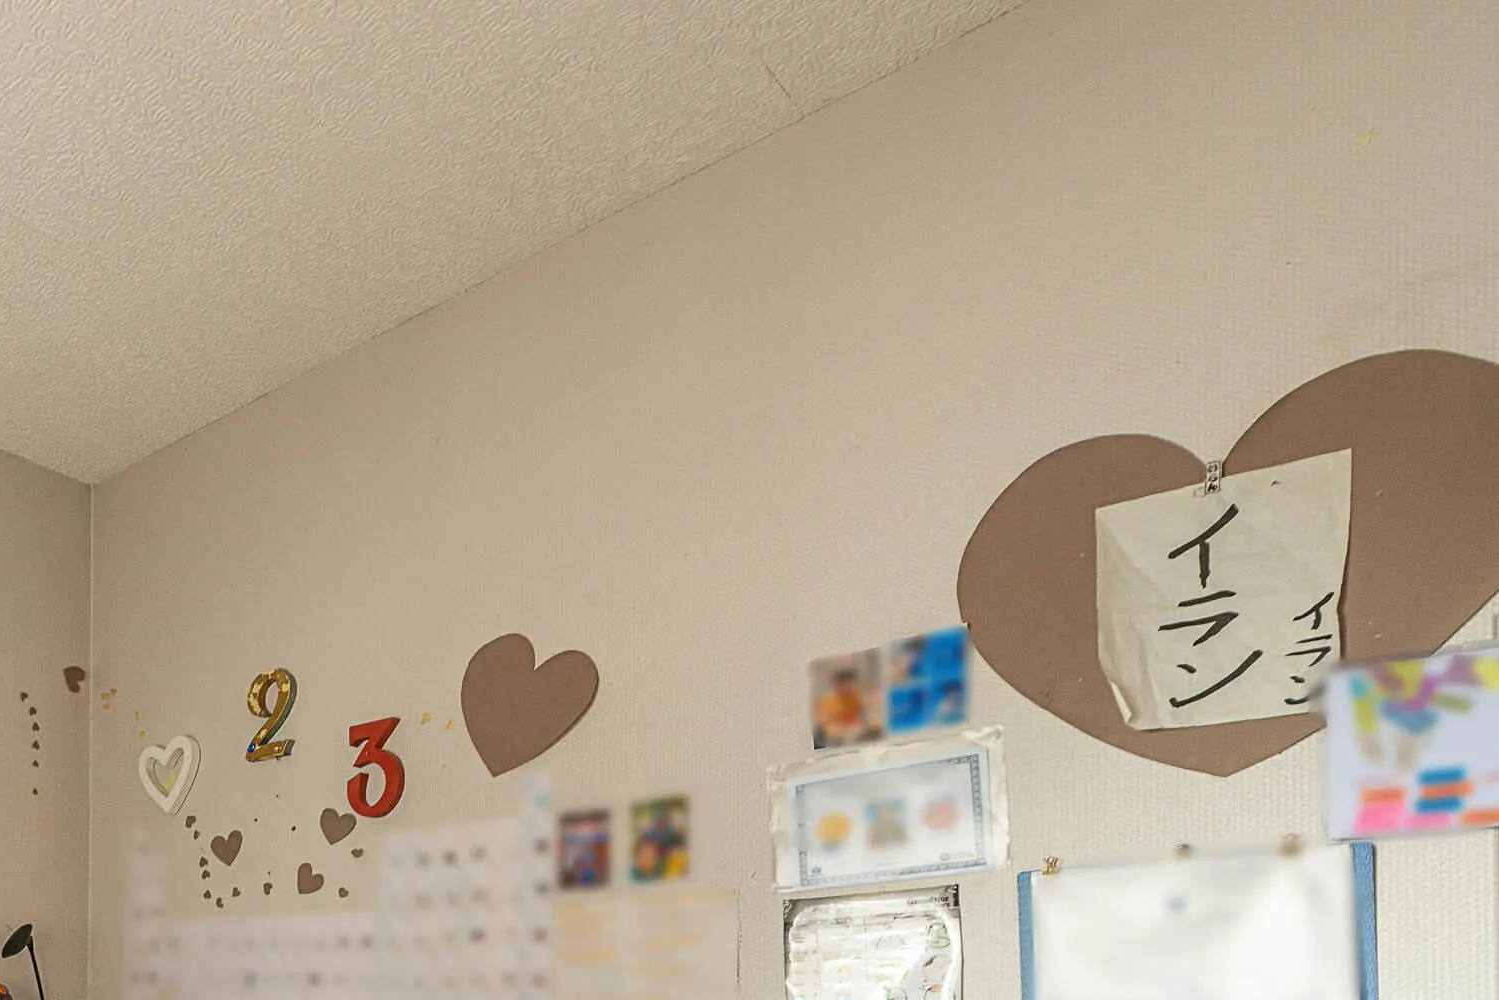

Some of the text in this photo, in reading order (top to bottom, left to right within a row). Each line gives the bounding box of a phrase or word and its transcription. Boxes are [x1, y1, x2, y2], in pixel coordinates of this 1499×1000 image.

[1158, 503, 1263, 708] イラン
[246, 668, 406, 818] 2 3
